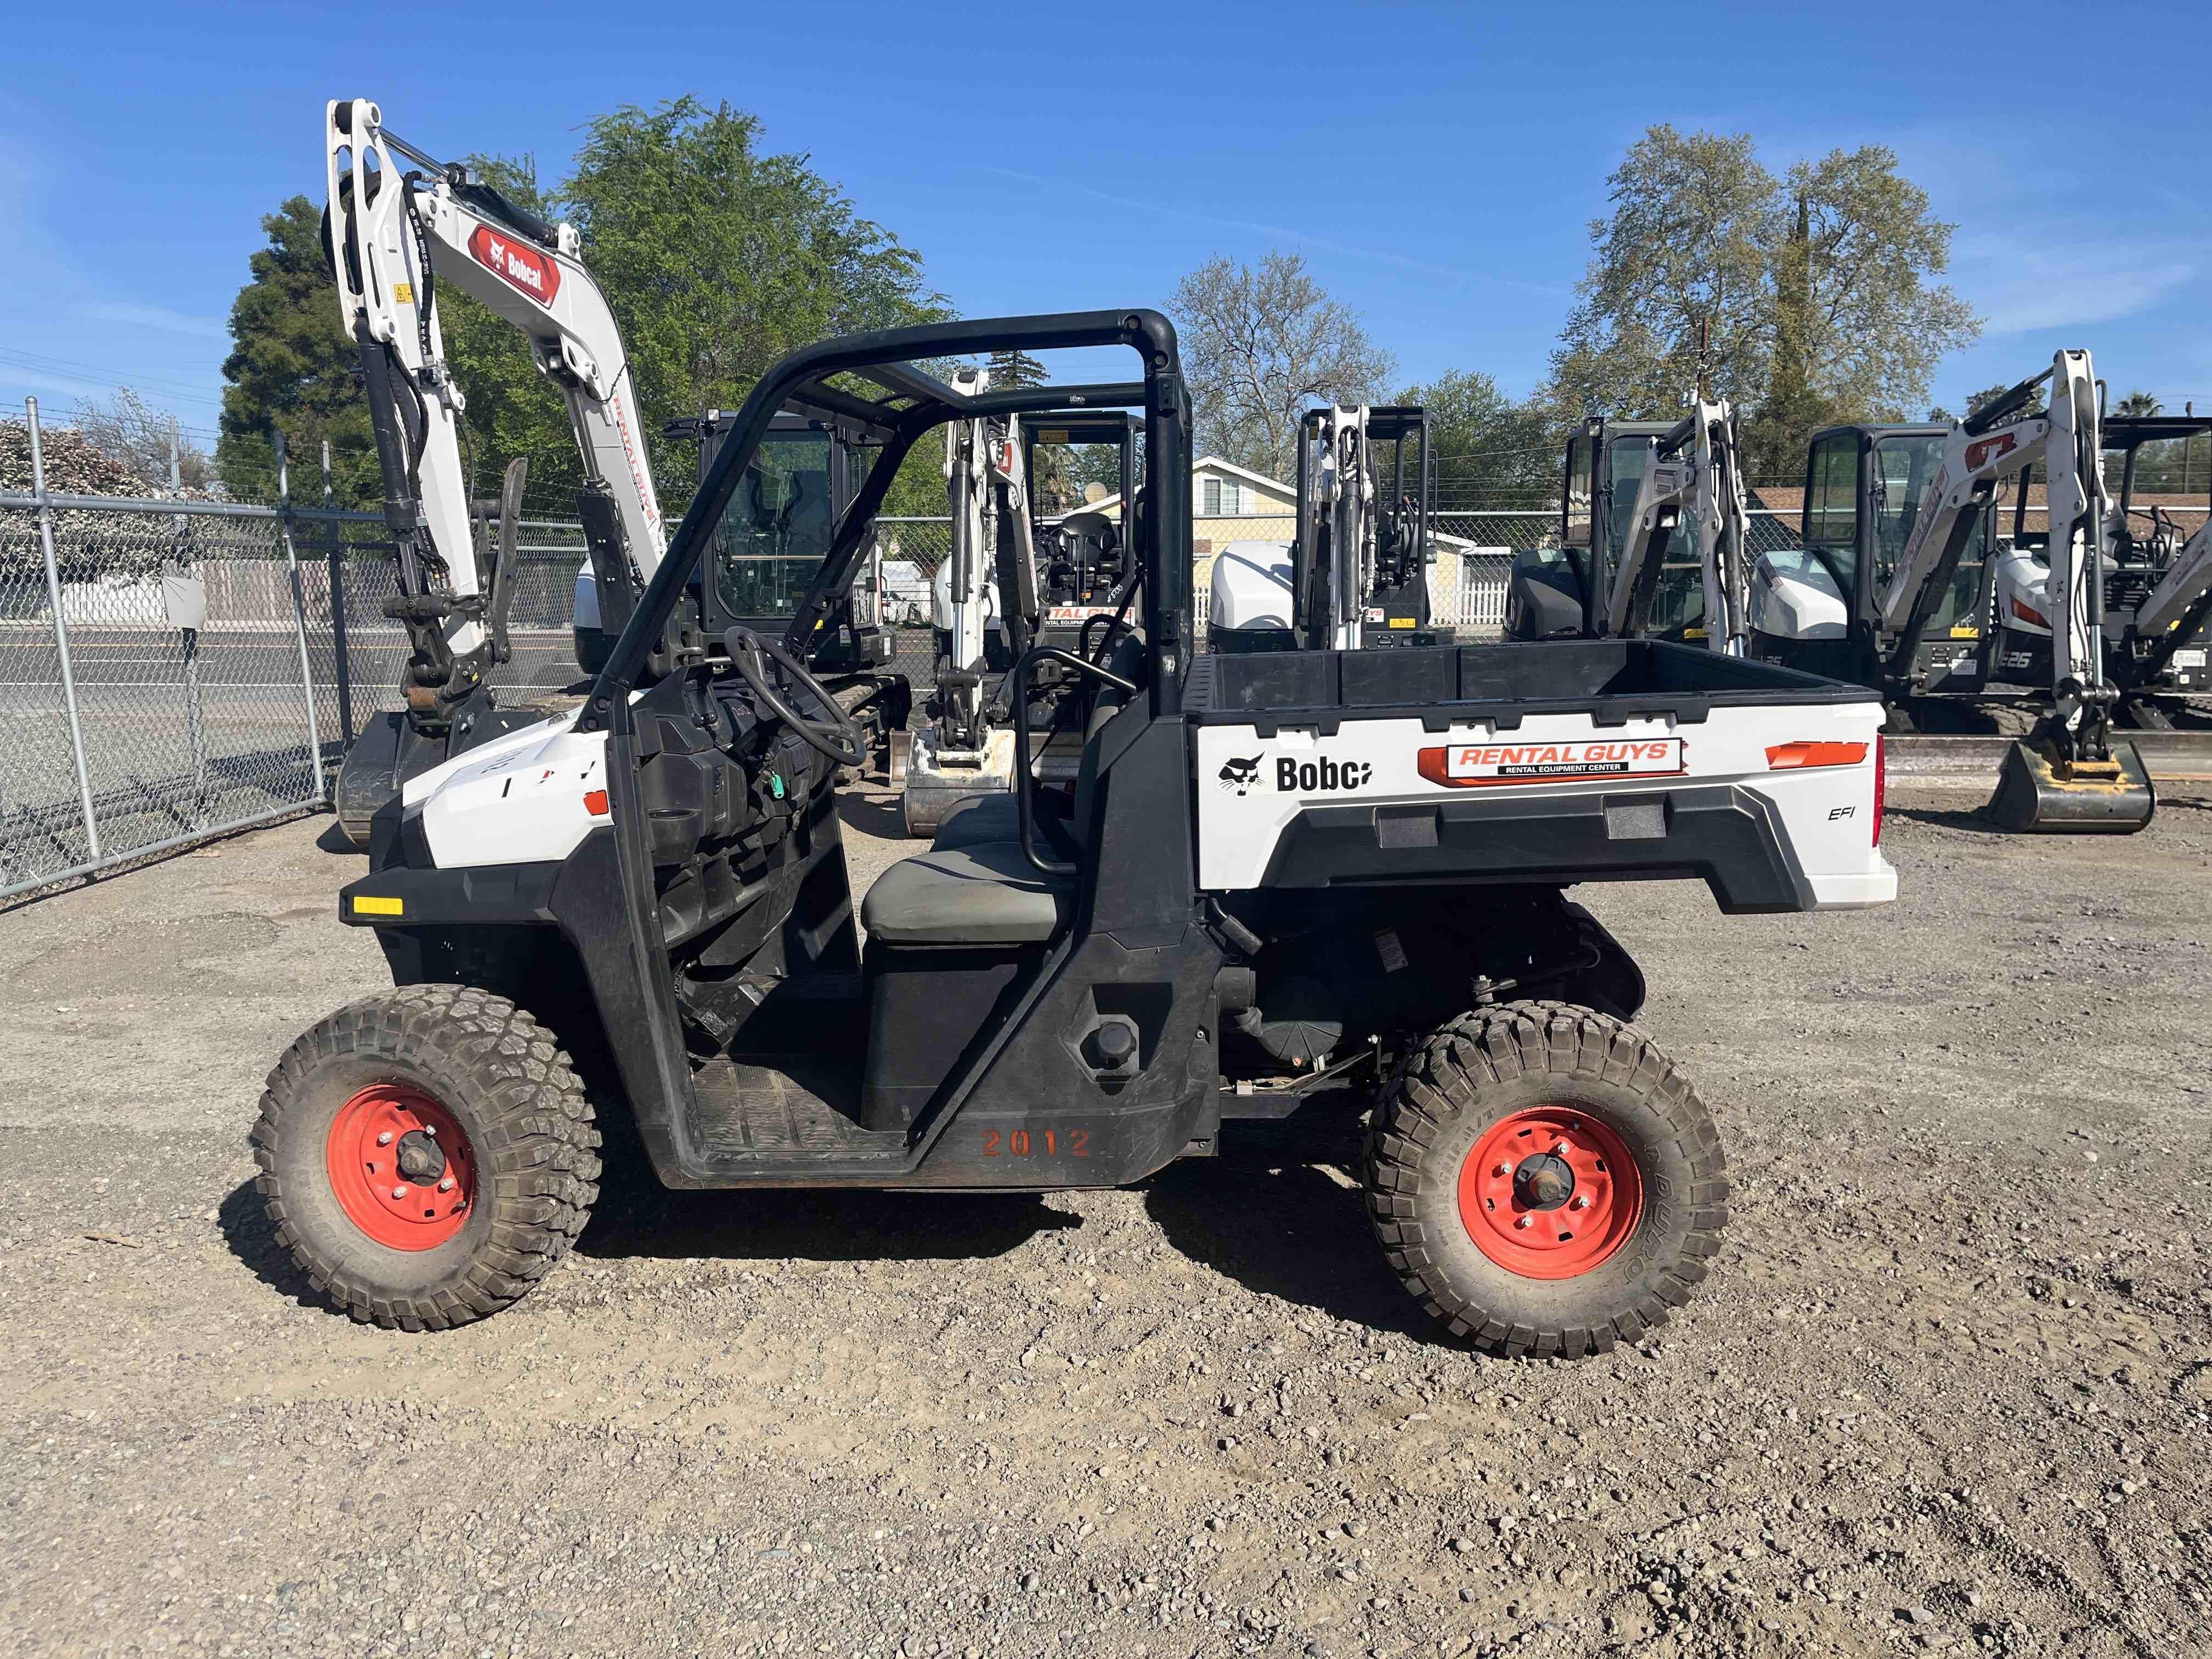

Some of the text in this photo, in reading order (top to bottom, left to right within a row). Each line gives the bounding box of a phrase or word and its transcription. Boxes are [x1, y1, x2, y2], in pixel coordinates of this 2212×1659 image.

[508, 252, 542, 291] Bobcat
[1053, 608, 1084, 618] TAL
[1459, 743, 1668, 765] RENTAL GUYS
[1538, 764, 1587, 773] EQUIPMENT
[1828, 806, 1855, 821] EFI
[983, 1129, 1089, 1156] 2012
[1623, 1173, 1673, 1282] DURO
